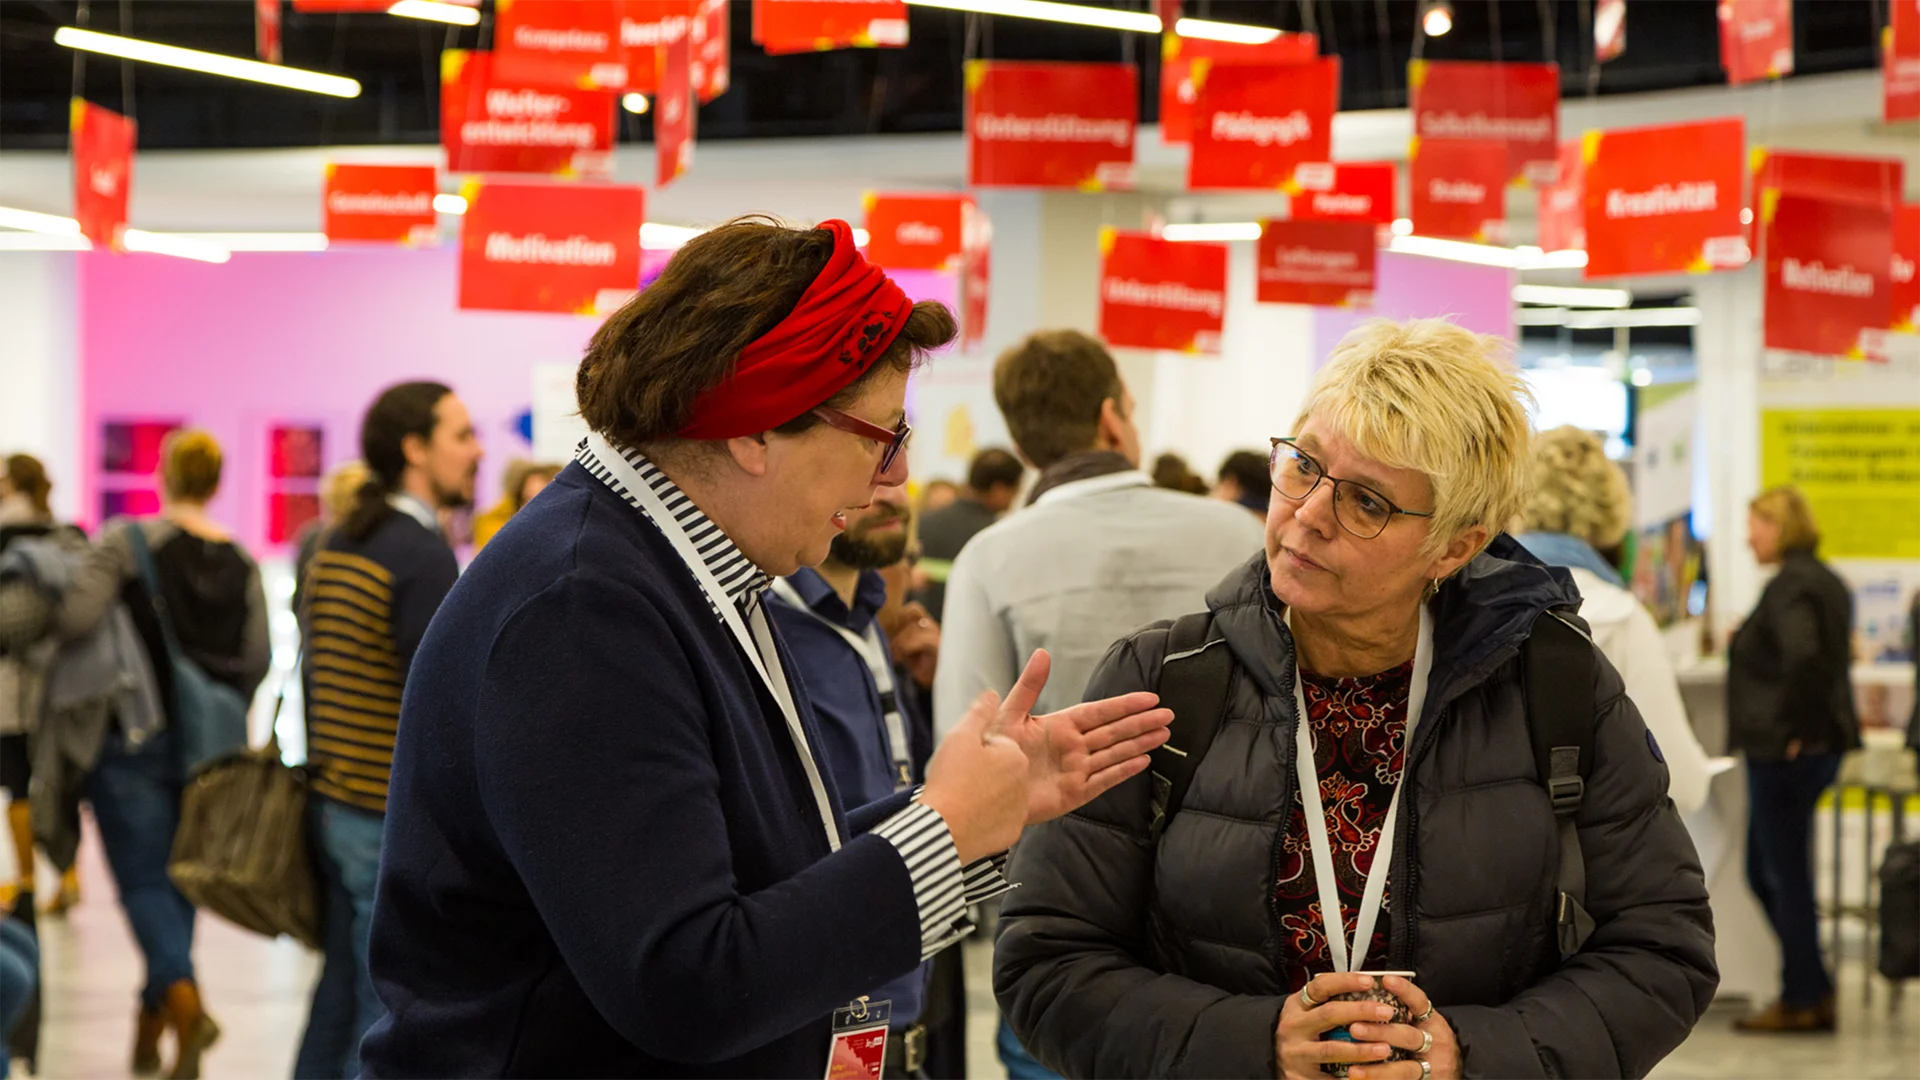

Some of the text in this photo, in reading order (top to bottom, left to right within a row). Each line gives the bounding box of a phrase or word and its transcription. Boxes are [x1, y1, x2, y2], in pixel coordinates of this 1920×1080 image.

[976, 114, 1130, 147] Unterstützung
[1212, 110, 1310, 146] Pädagogik
[1606, 181, 1716, 219] Kreativität
[486, 232, 615, 265] Motivation
[1781, 258, 1873, 297] Motivation
[1105, 277, 1222, 316] Unterstützung
